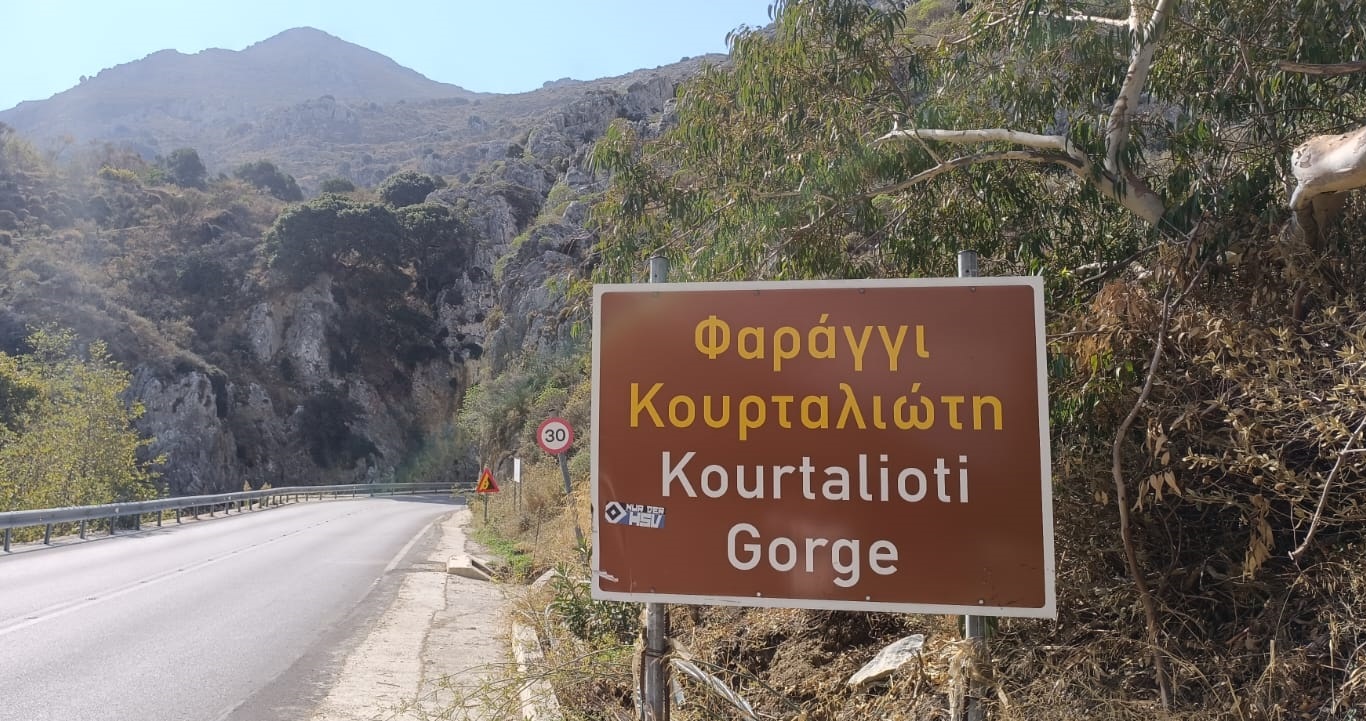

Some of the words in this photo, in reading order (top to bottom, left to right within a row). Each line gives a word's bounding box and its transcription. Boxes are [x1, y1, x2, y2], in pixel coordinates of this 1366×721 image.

[694, 313, 930, 372] Φαράγγι
[544, 428, 566, 443] 30
[629, 382, 1003, 441] Κουρταλιώτη
[661, 451, 969, 503] Kourtalioti
[625, 504, 644, 512] NUR
[646, 505, 665, 514] DER
[629, 512, 662, 528] HSV
[727, 523, 899, 588] Gorge
